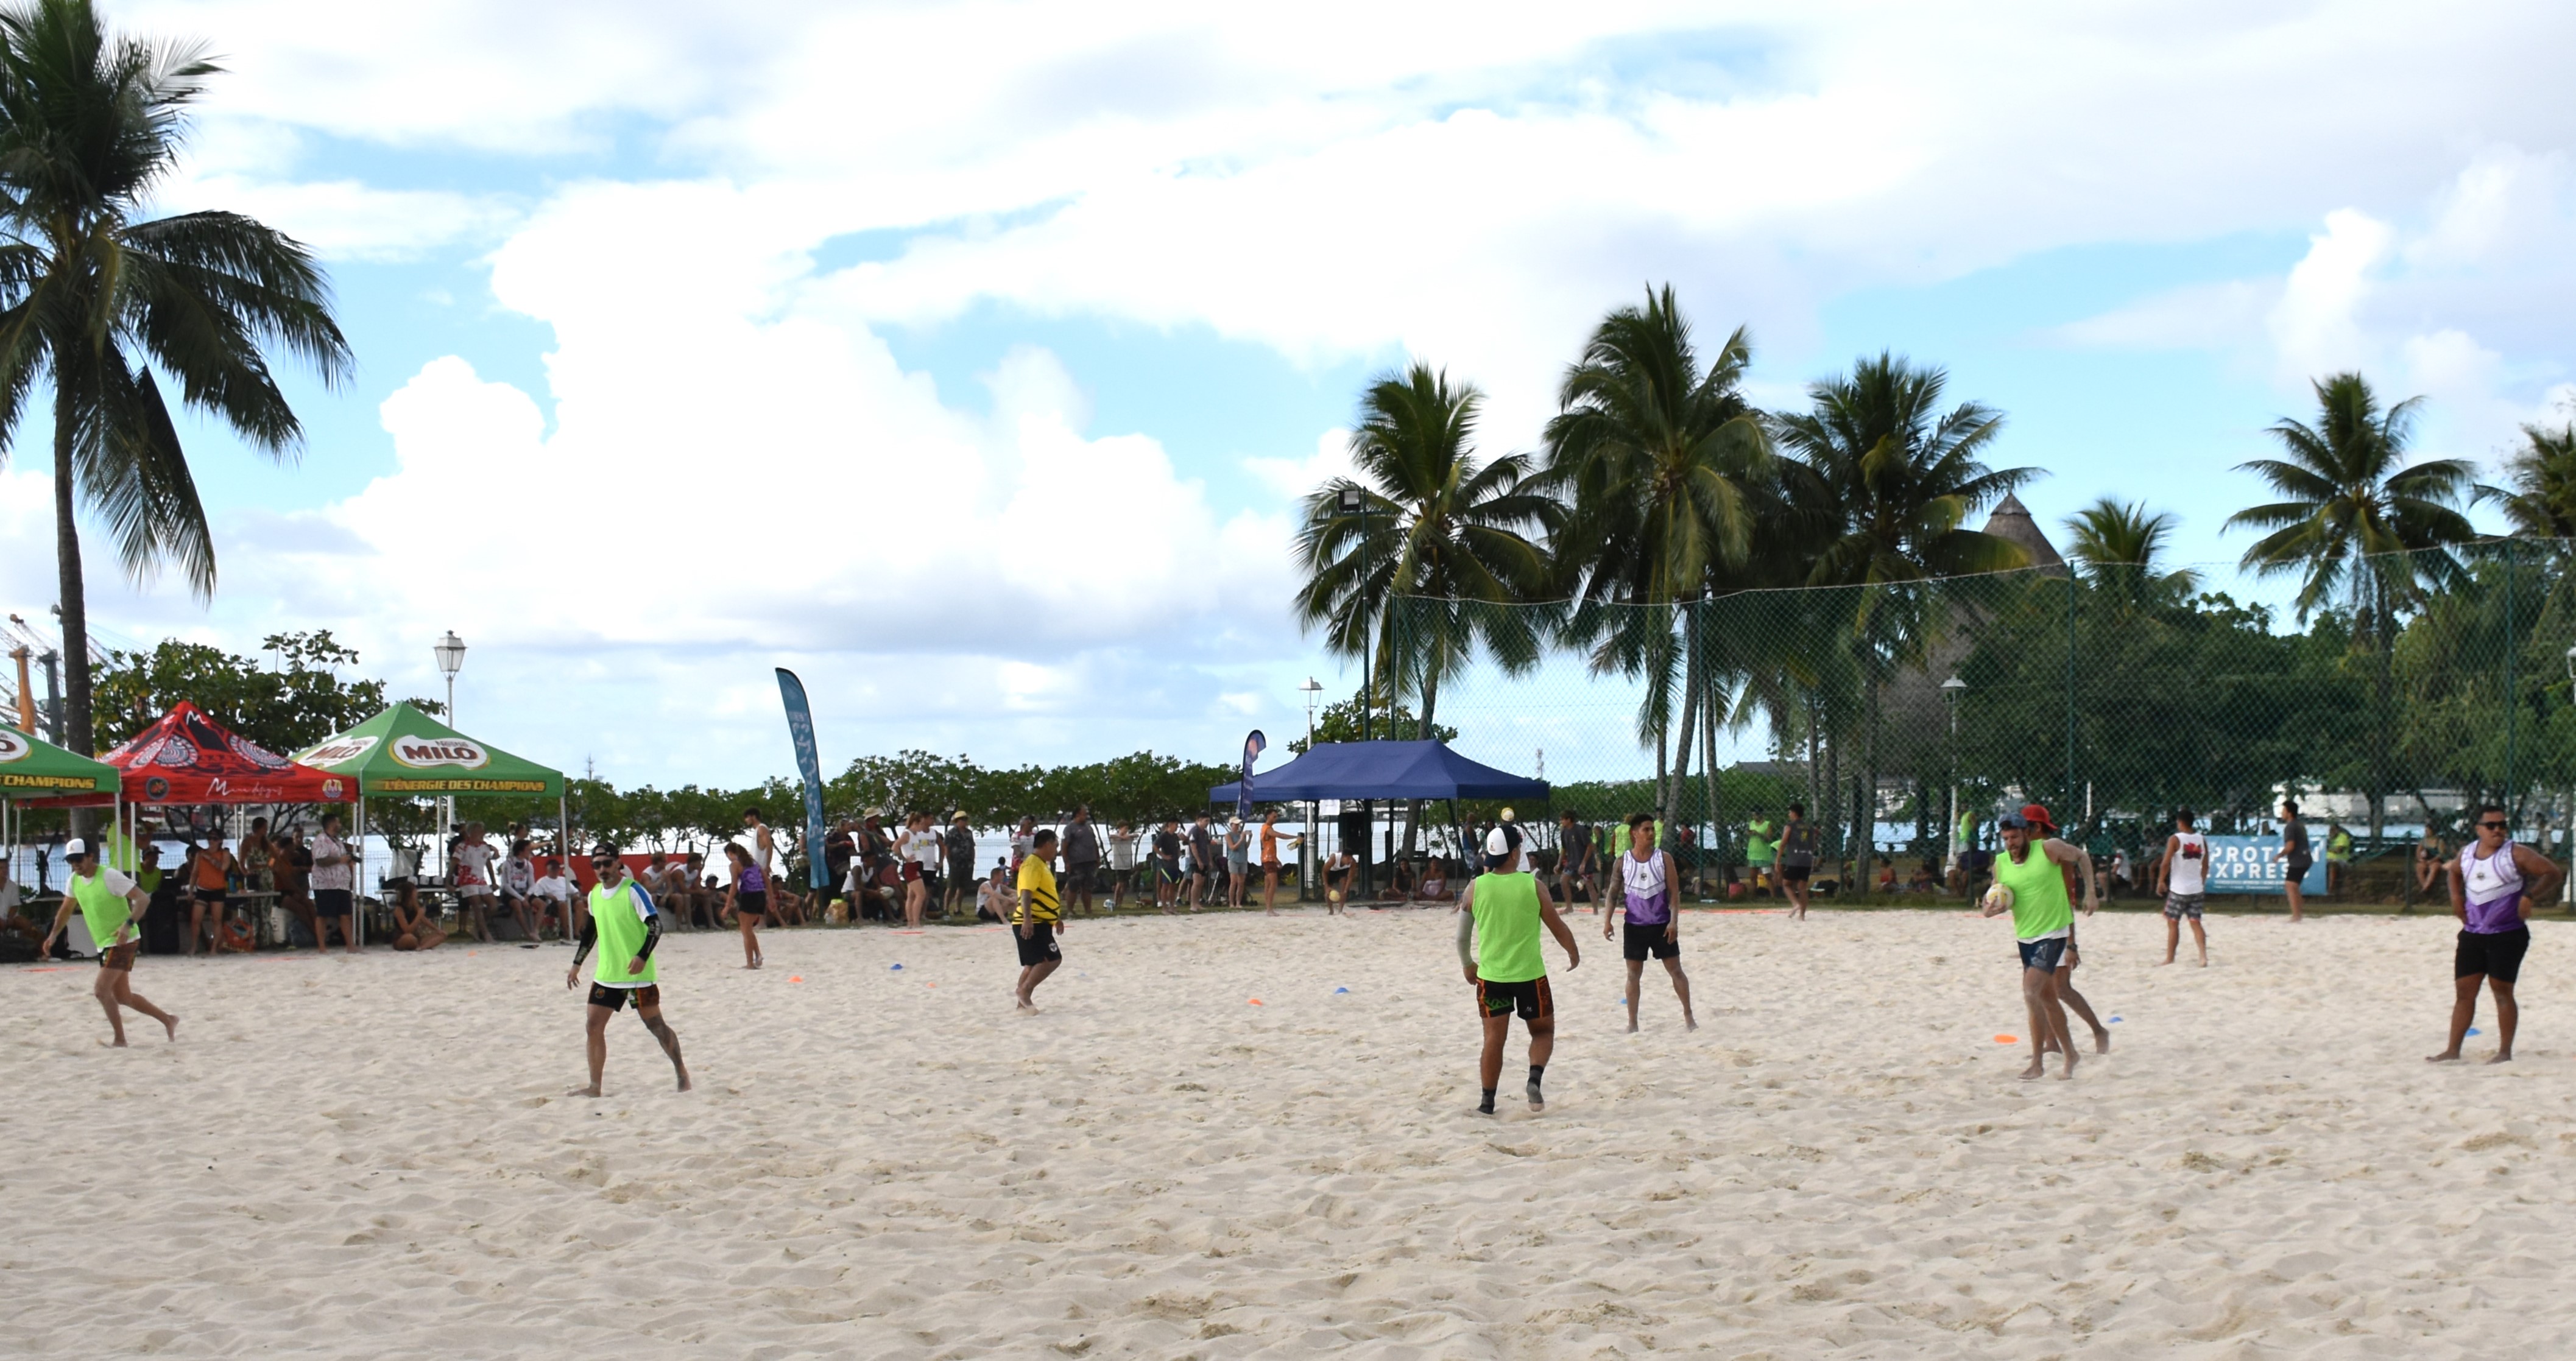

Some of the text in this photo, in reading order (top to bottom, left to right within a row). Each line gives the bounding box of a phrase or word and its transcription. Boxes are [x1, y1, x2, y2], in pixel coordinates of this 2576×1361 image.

[306, 746, 362, 761] MILO
[402, 746, 478, 760] MILO
[4, 775, 96, 789] CHAMPIONS
[385, 778, 545, 791] L'ÉNERGIE DES CHAMPIONS
[2209, 846, 2320, 863] PROTEN
